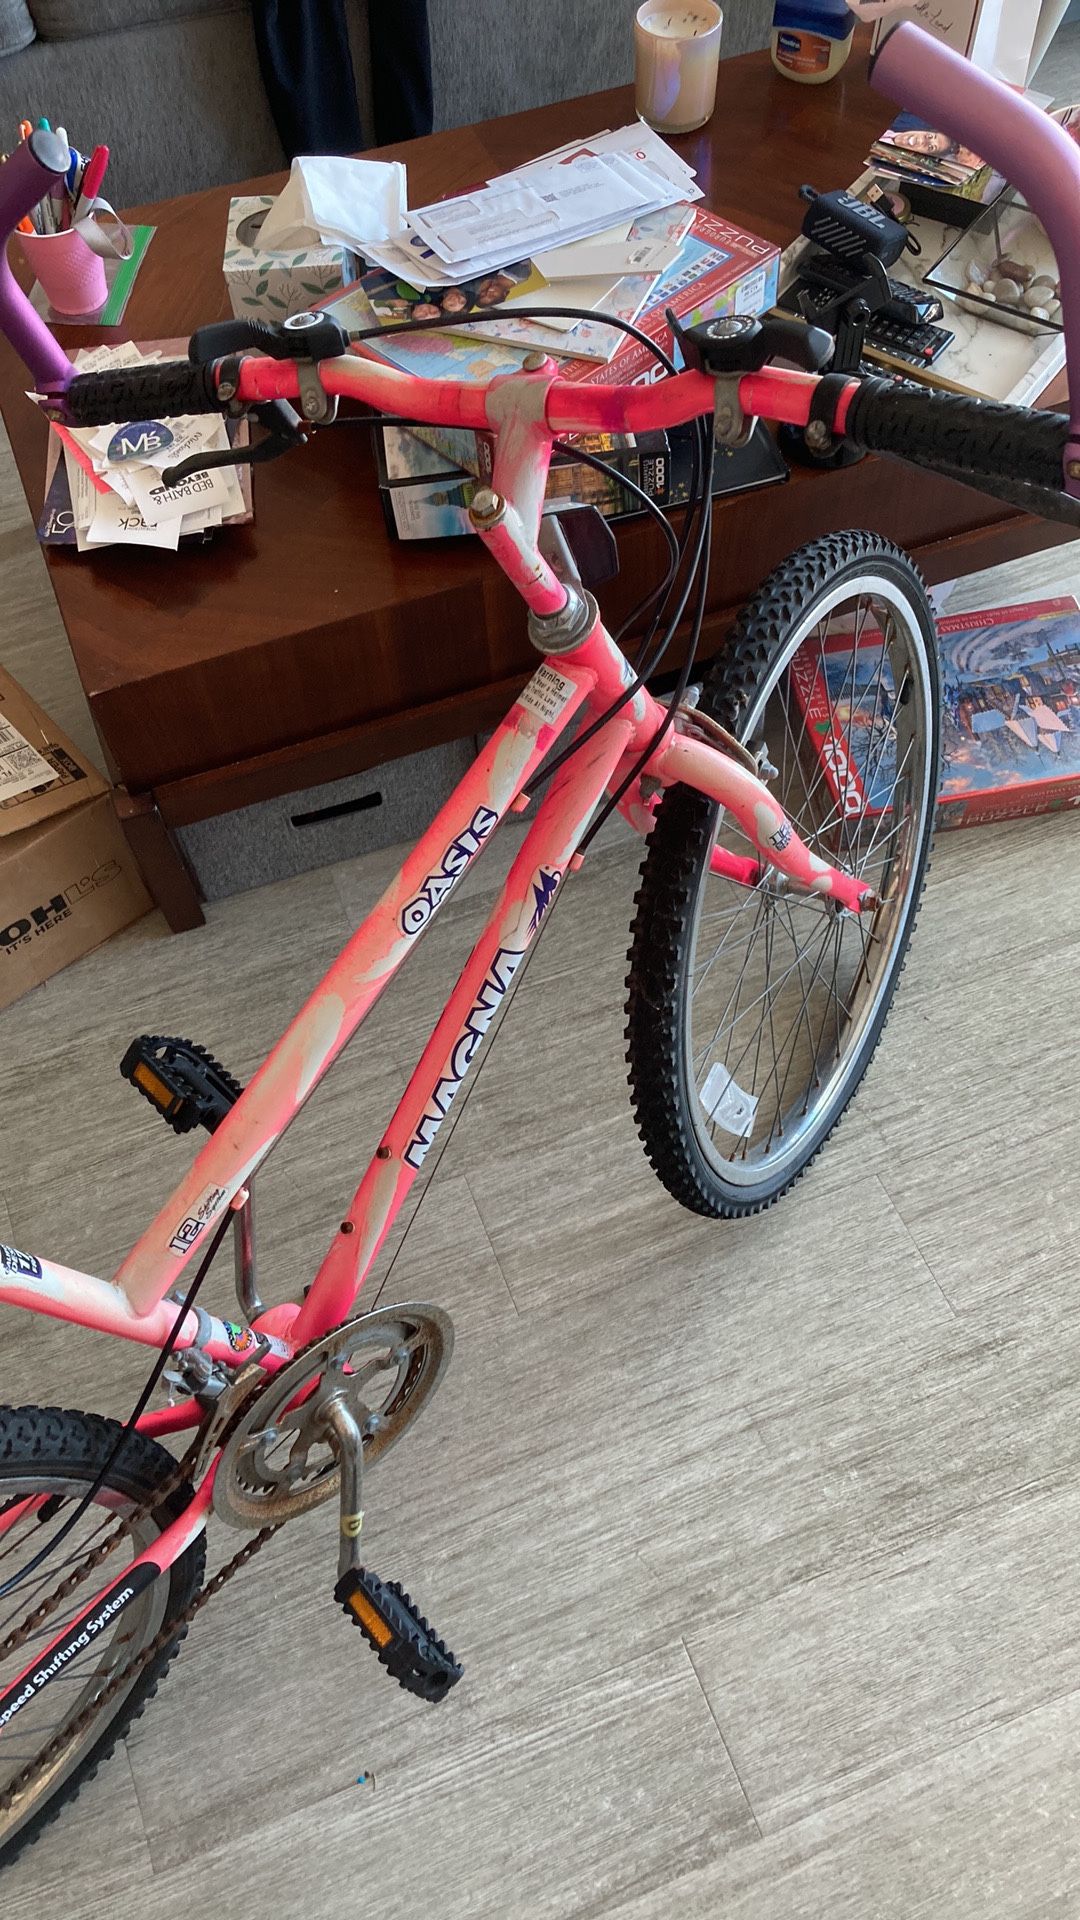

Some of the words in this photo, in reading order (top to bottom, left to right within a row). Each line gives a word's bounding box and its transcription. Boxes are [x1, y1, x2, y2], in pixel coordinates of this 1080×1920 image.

[837, 194, 885, 229] JBL
[667, 281, 706, 308] AMERICA
[619, 355, 631, 368] OF
[194, 479, 214, 494] BED
[656, 457, 664, 489] 1000
[153, 495, 162, 505] &
[164, 484, 192, 503] BATH
[822, 735, 861, 815] 1000
[401, 805, 499, 935] OASIS
[0, 860, 122, 947] OHL'S
[5, 935, 32, 955] IT'S
[35, 911, 73, 936] HERE
[404, 948, 526, 1170] MAGNA
[169, 1217, 205, 1254] 12
[33, 1631, 90, 1687] Shifting
[86, 1587, 135, 1634] System
